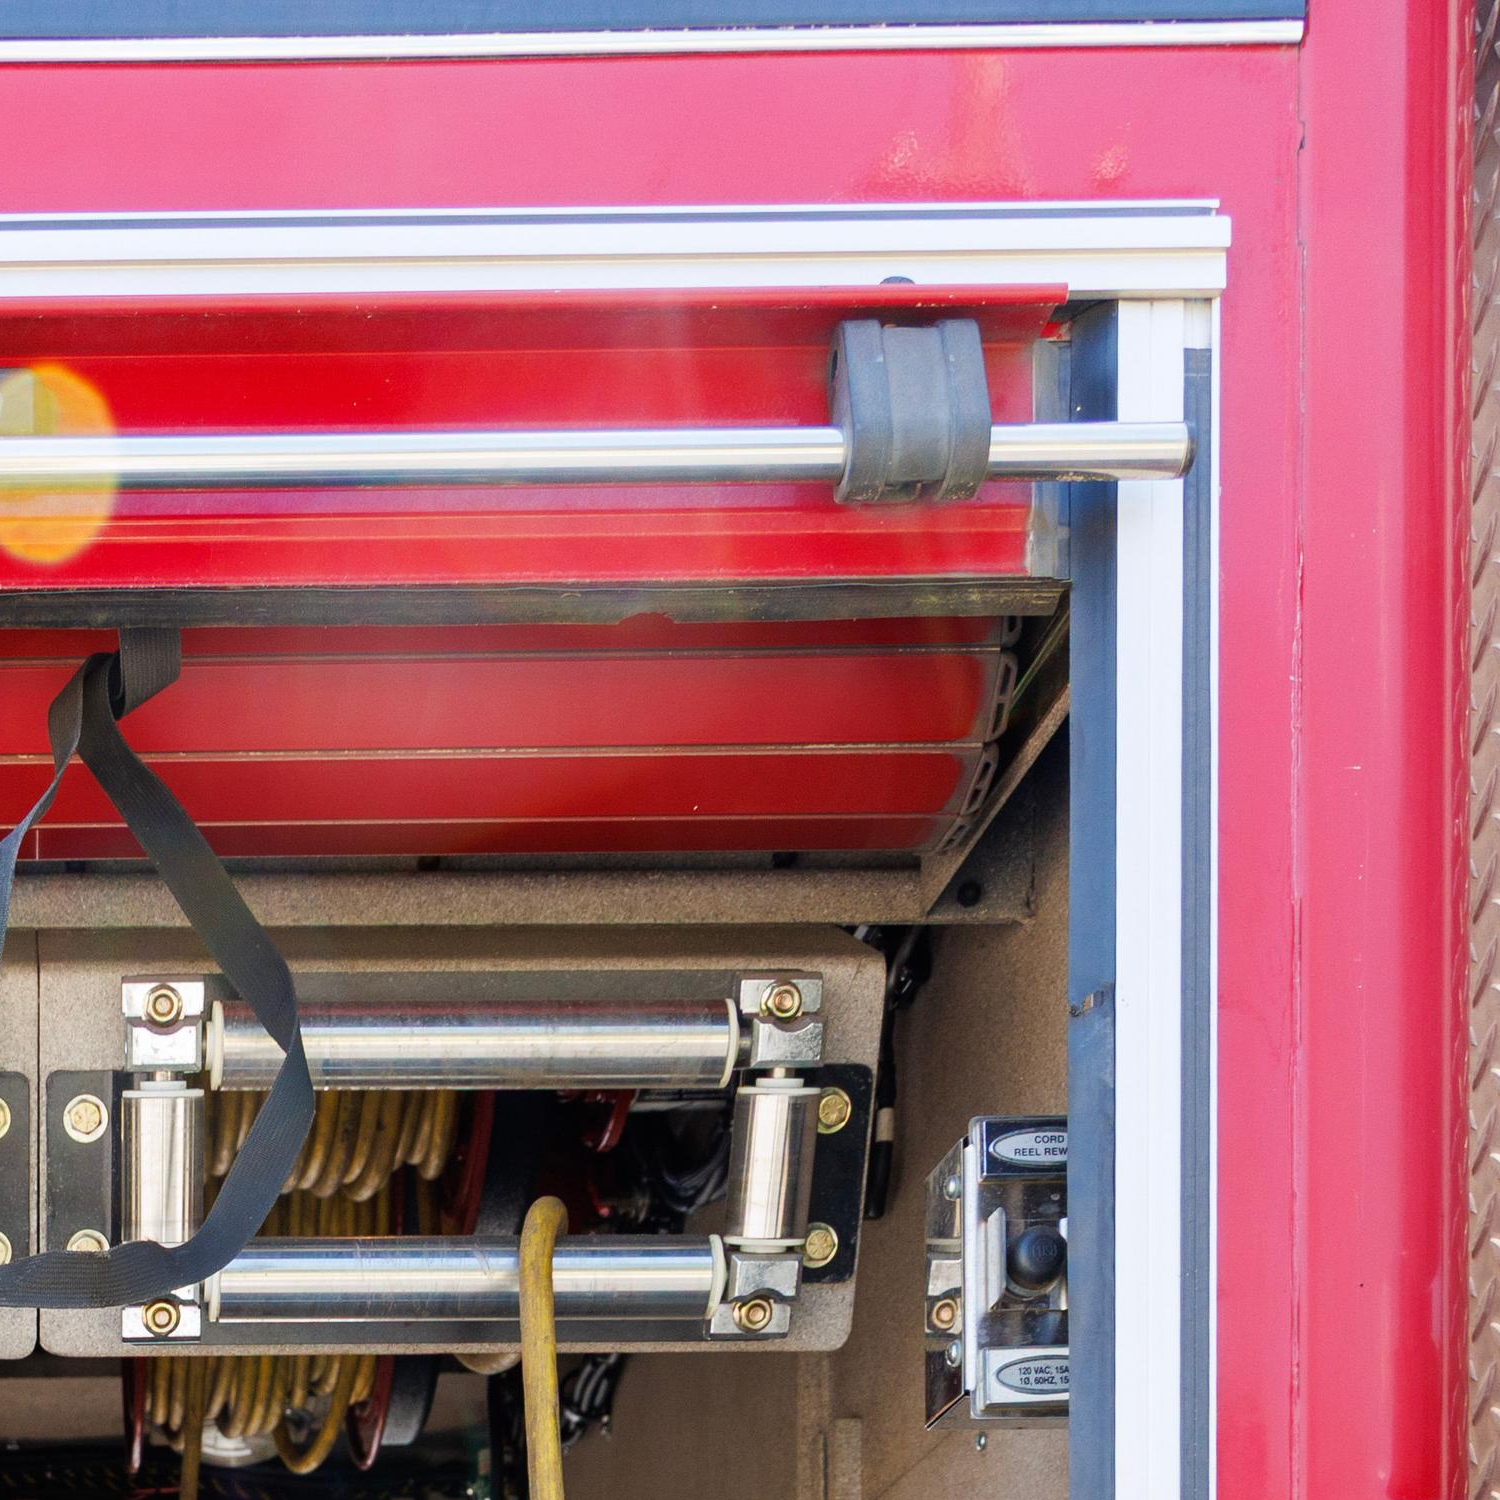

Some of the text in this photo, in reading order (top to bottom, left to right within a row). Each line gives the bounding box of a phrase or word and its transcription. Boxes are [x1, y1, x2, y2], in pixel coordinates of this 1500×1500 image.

[1034, 1135, 1065, 1144] CORD
[1014, 1147, 1041, 1156] REEL
[1018, 1366, 1032, 1375] 120
[1033, 1365, 1053, 1375] VAC,
